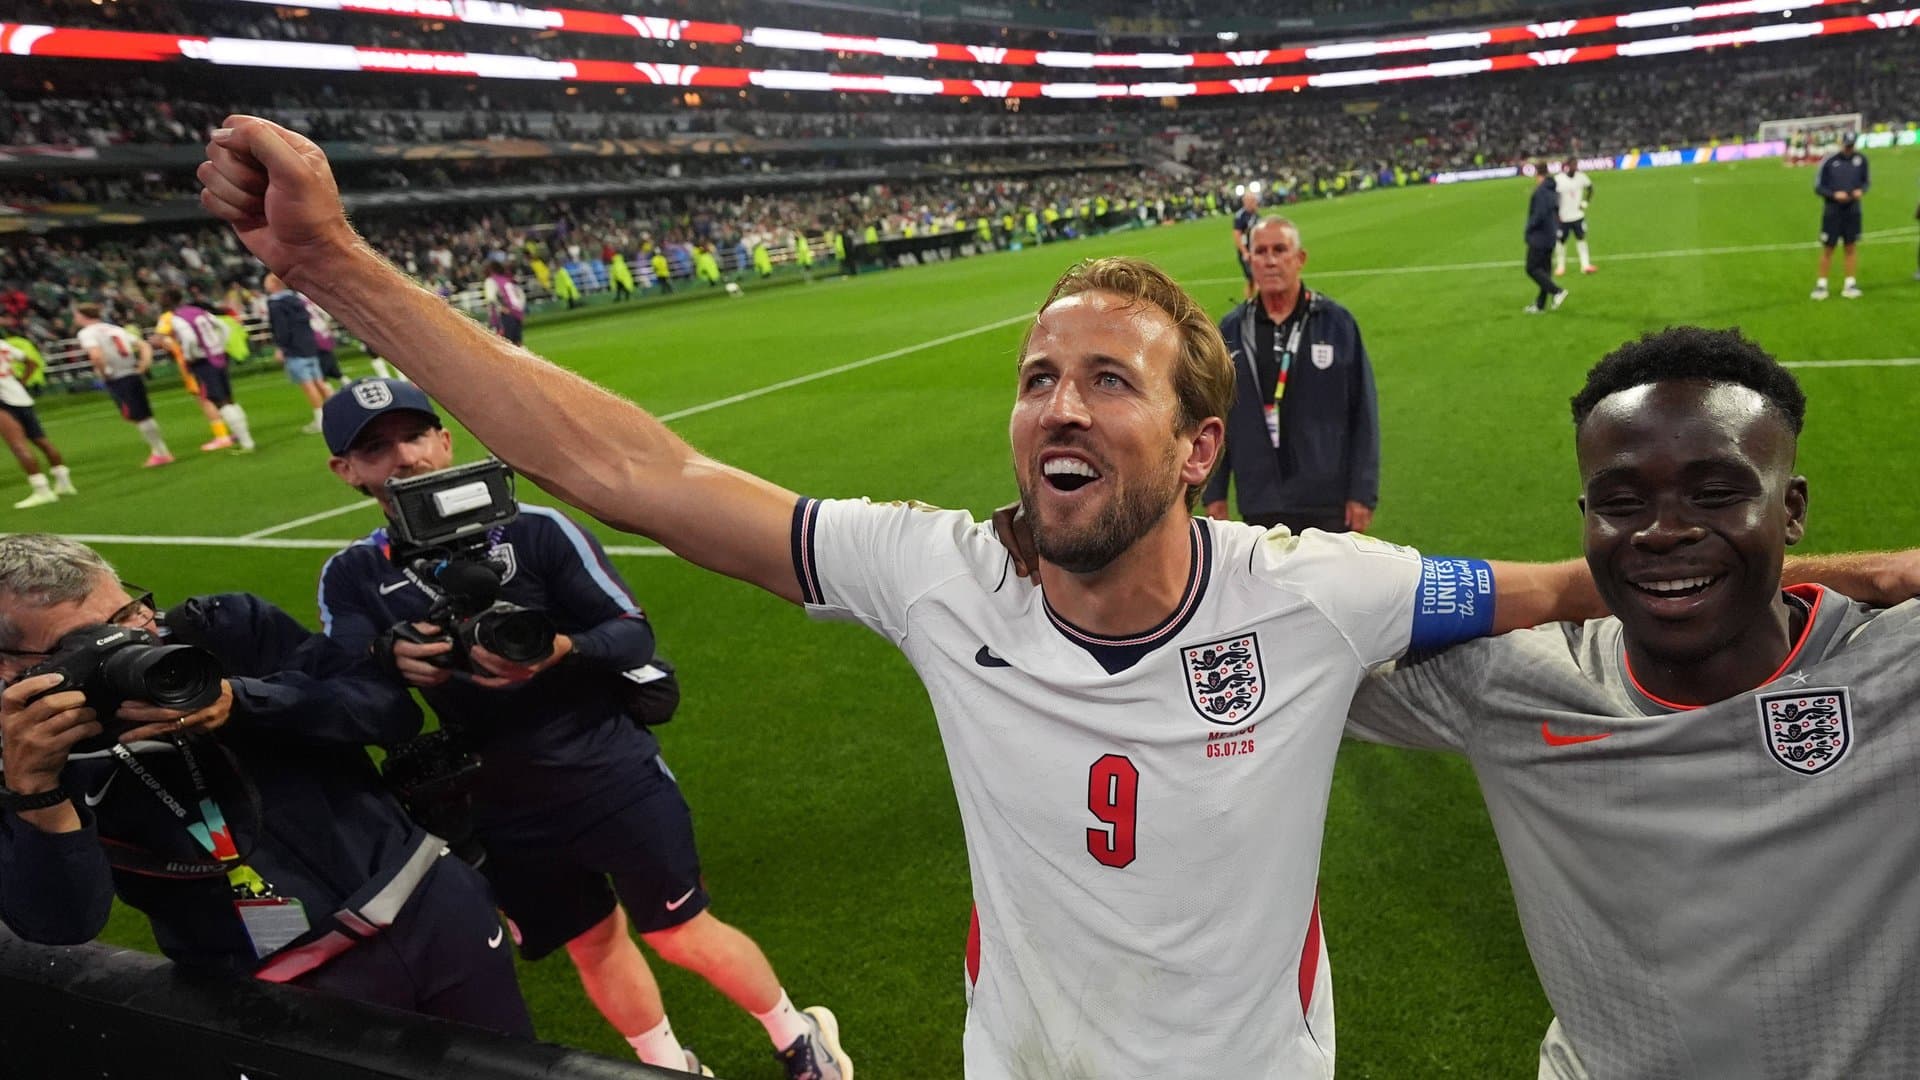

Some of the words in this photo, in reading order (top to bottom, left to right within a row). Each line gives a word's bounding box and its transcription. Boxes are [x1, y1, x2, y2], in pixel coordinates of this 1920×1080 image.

[1434, 559, 1457, 614] UNITES
[1480, 570, 1489, 591] FIFA
[1457, 589, 1475, 619] the
[96, 631, 124, 646] Canon
[1207, 739, 1254, 758] 05.07.26
[112, 743, 145, 775] WORLD
[141, 773, 161, 790] CUP
[155, 788, 187, 818] 2026
[1086, 753, 1139, 869] 9
